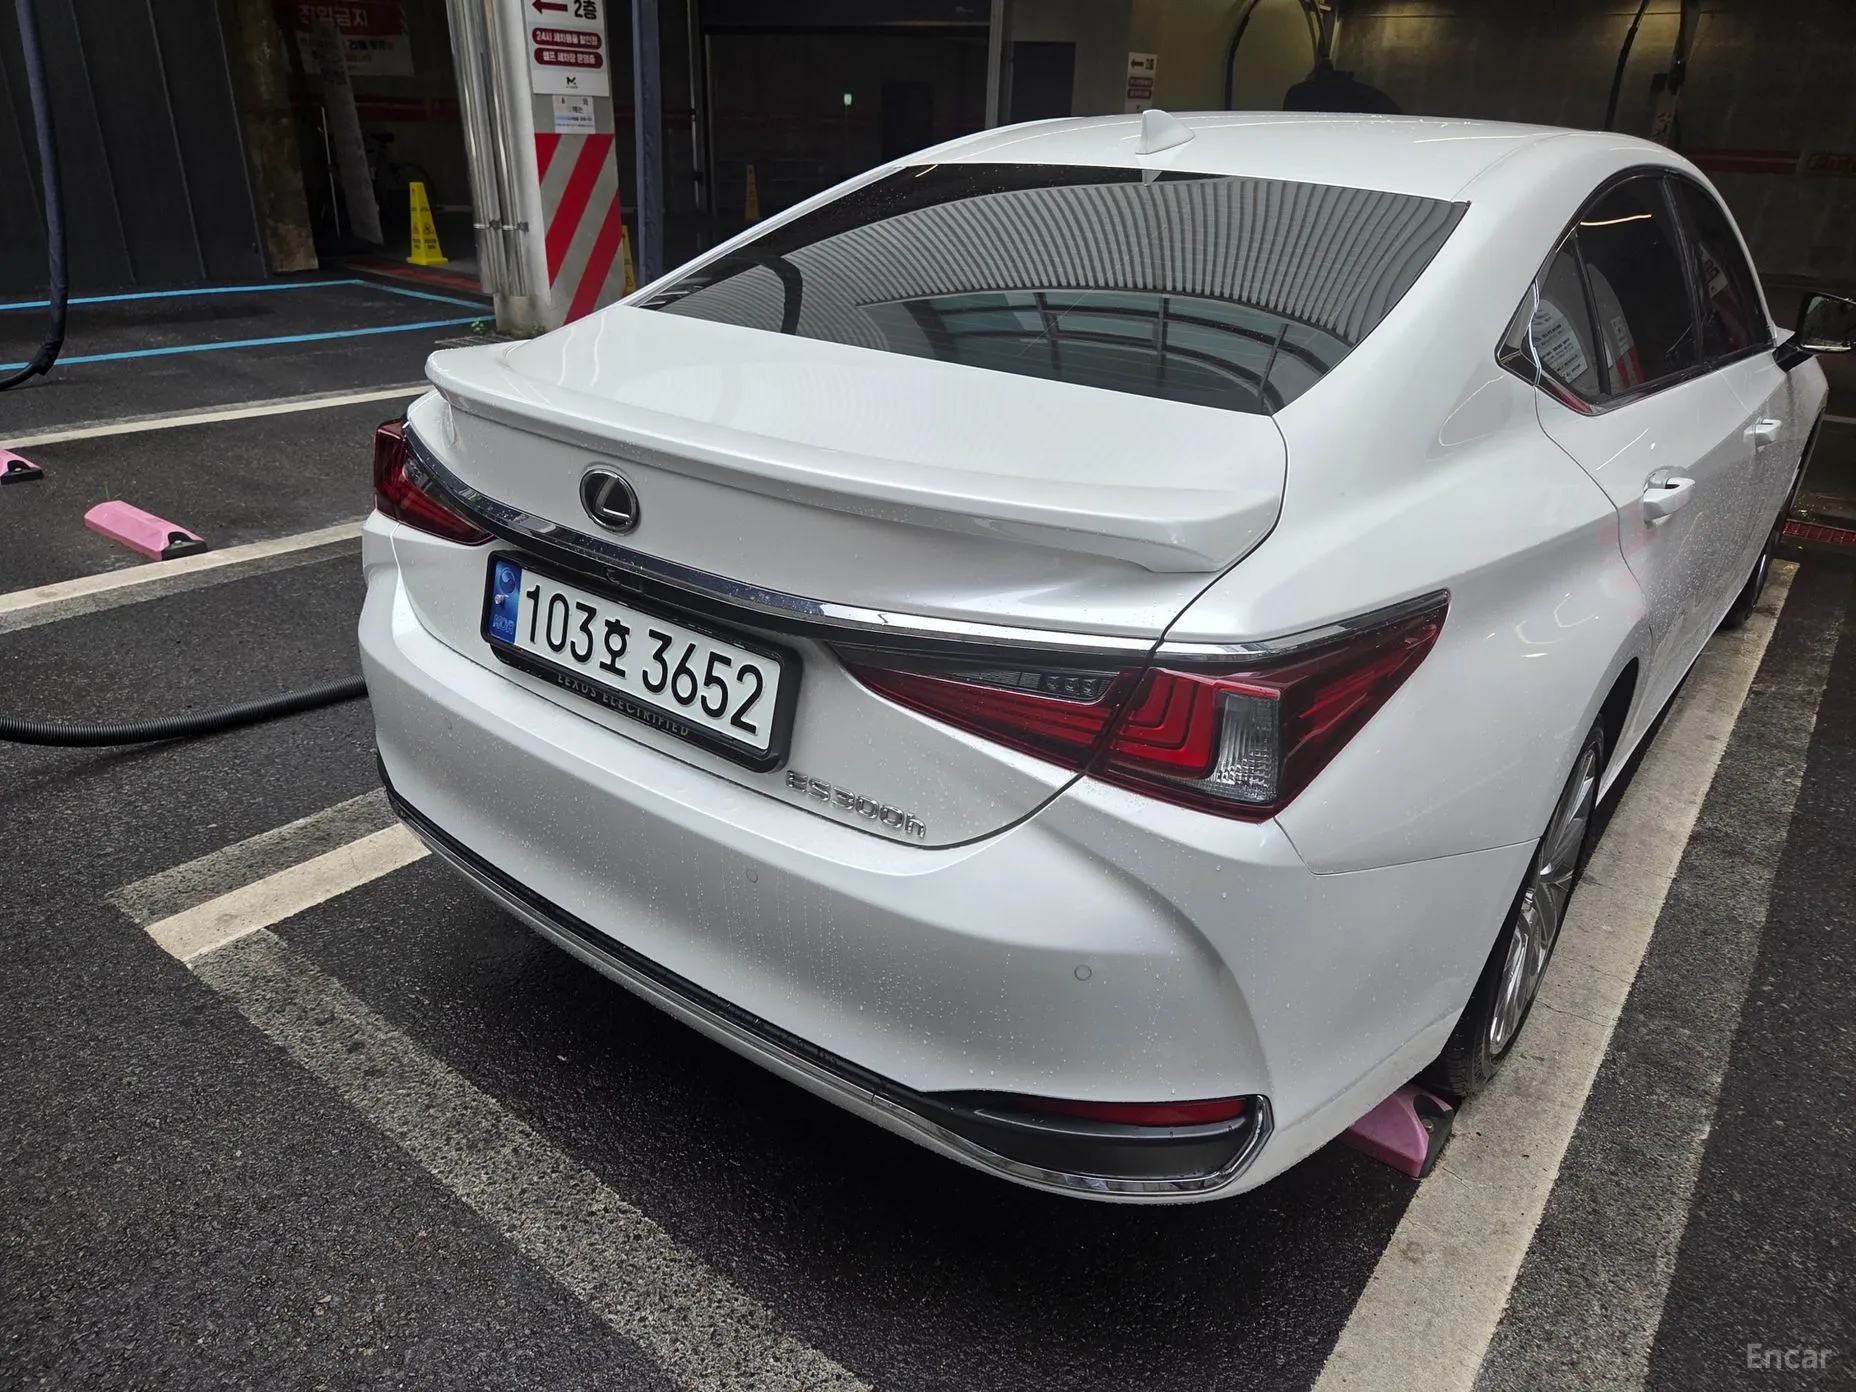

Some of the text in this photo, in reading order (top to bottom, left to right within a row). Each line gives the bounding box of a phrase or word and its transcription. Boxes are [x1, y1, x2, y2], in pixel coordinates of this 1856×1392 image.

[574, 0, 597, 19] 2층
[526, 583, 764, 735] 103호 3652
[556, 673, 690, 737] LEXUS ELECTRIFIED
[785, 769, 927, 839] ES300h
